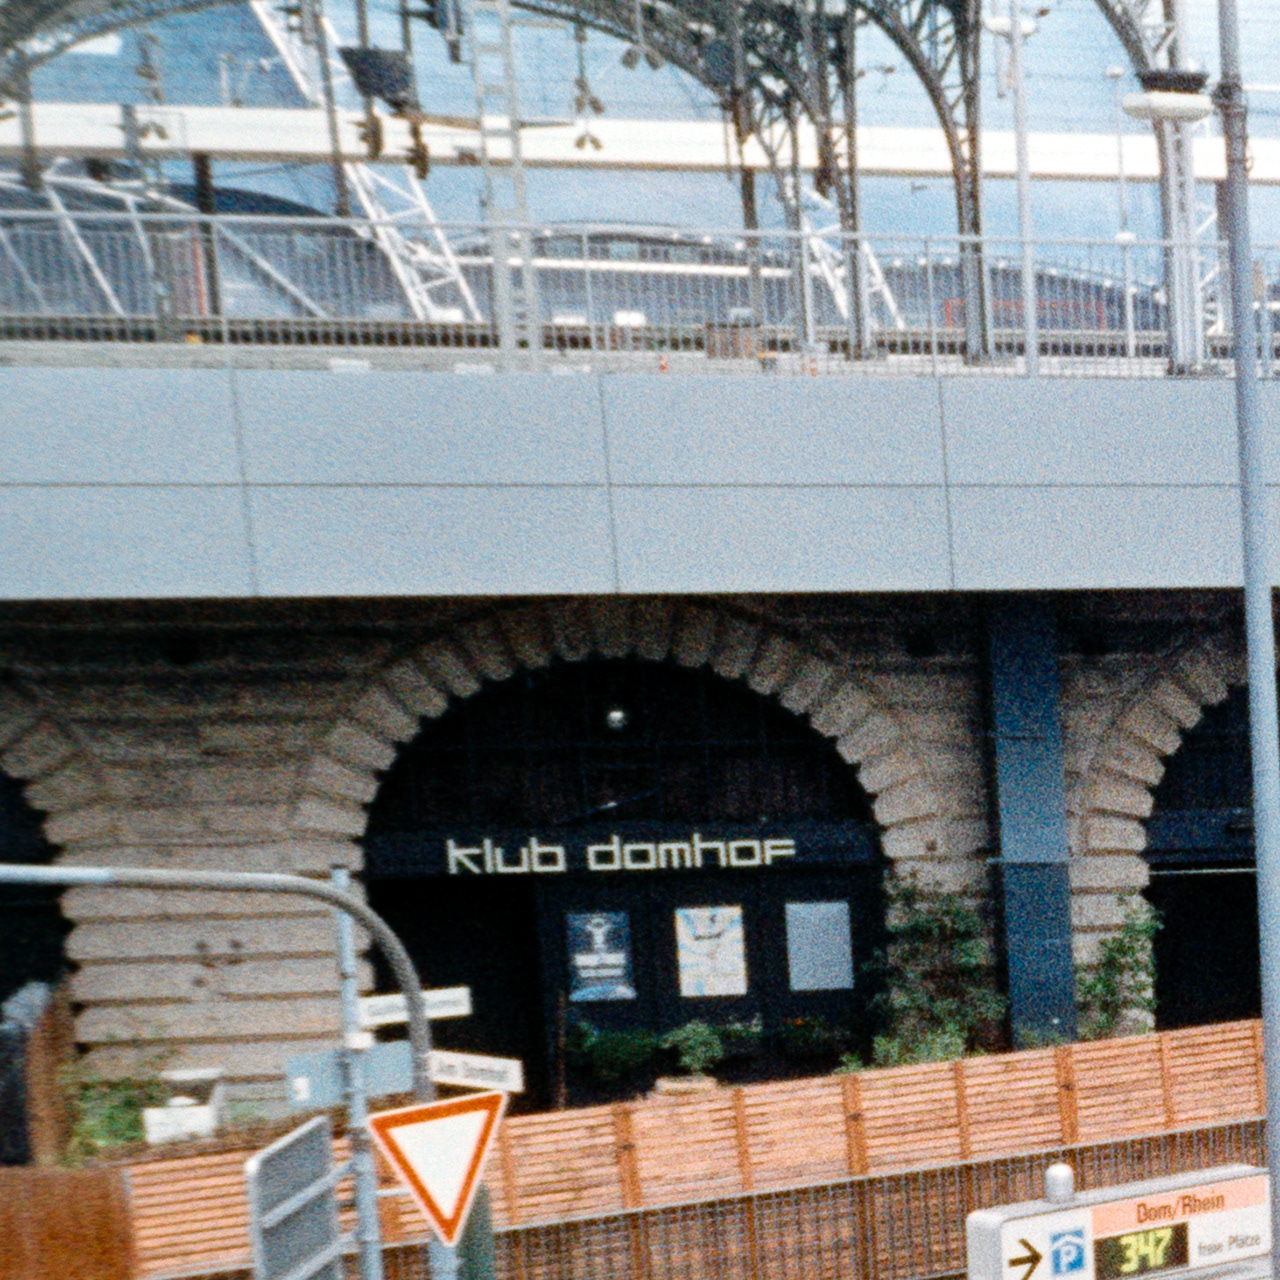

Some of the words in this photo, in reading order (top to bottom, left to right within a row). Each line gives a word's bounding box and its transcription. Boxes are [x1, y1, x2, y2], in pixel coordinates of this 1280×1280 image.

[447, 837, 566, 874] klub
[1136, 1194, 1225, 1223] Dom/Rhein
[1060, 1244, 1078, 1271] P
[1120, 1227, 1173, 1273] 347
